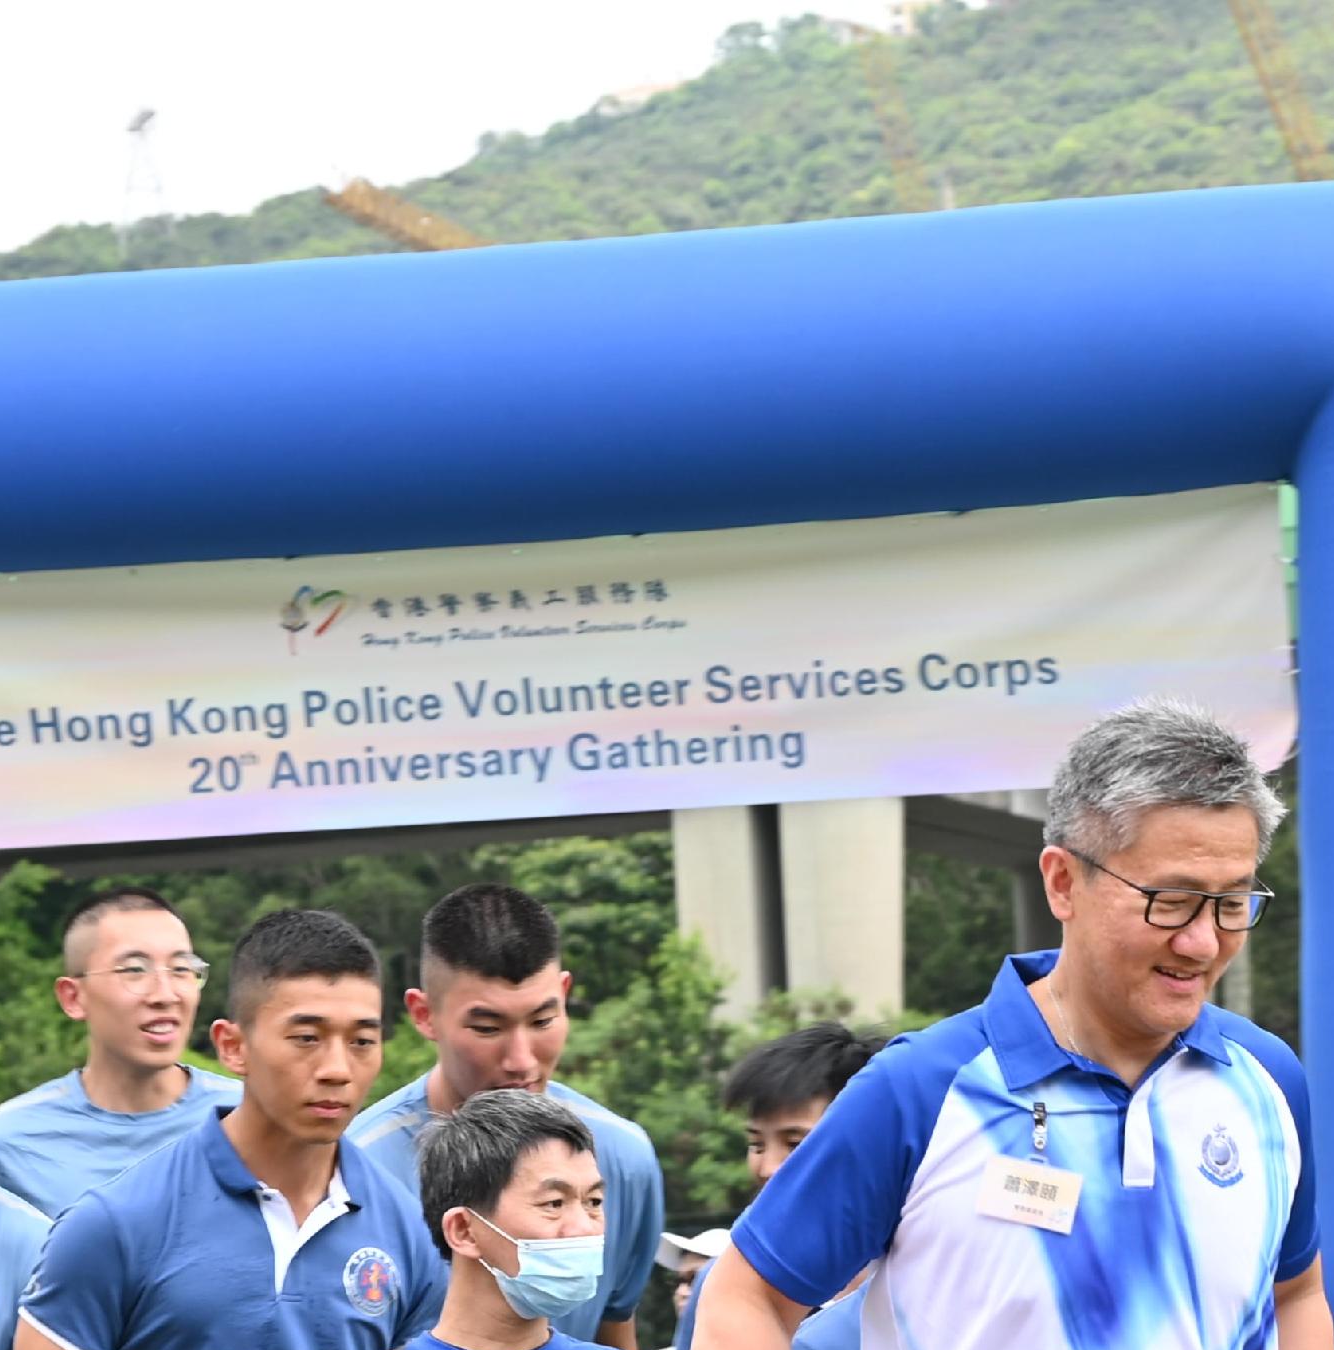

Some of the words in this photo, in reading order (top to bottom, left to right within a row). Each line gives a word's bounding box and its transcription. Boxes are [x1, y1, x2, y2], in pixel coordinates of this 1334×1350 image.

[29, 706, 153, 747] Hong
[166, 697, 288, 739] Kong
[302, 686, 443, 728] Police
[455, 676, 691, 718] Volunteer
[705, 660, 905, 703] Services
[918, 653, 1059, 696] Corps
[269, 741, 553, 790] Anniversary
[567, 725, 807, 773] Gathering
